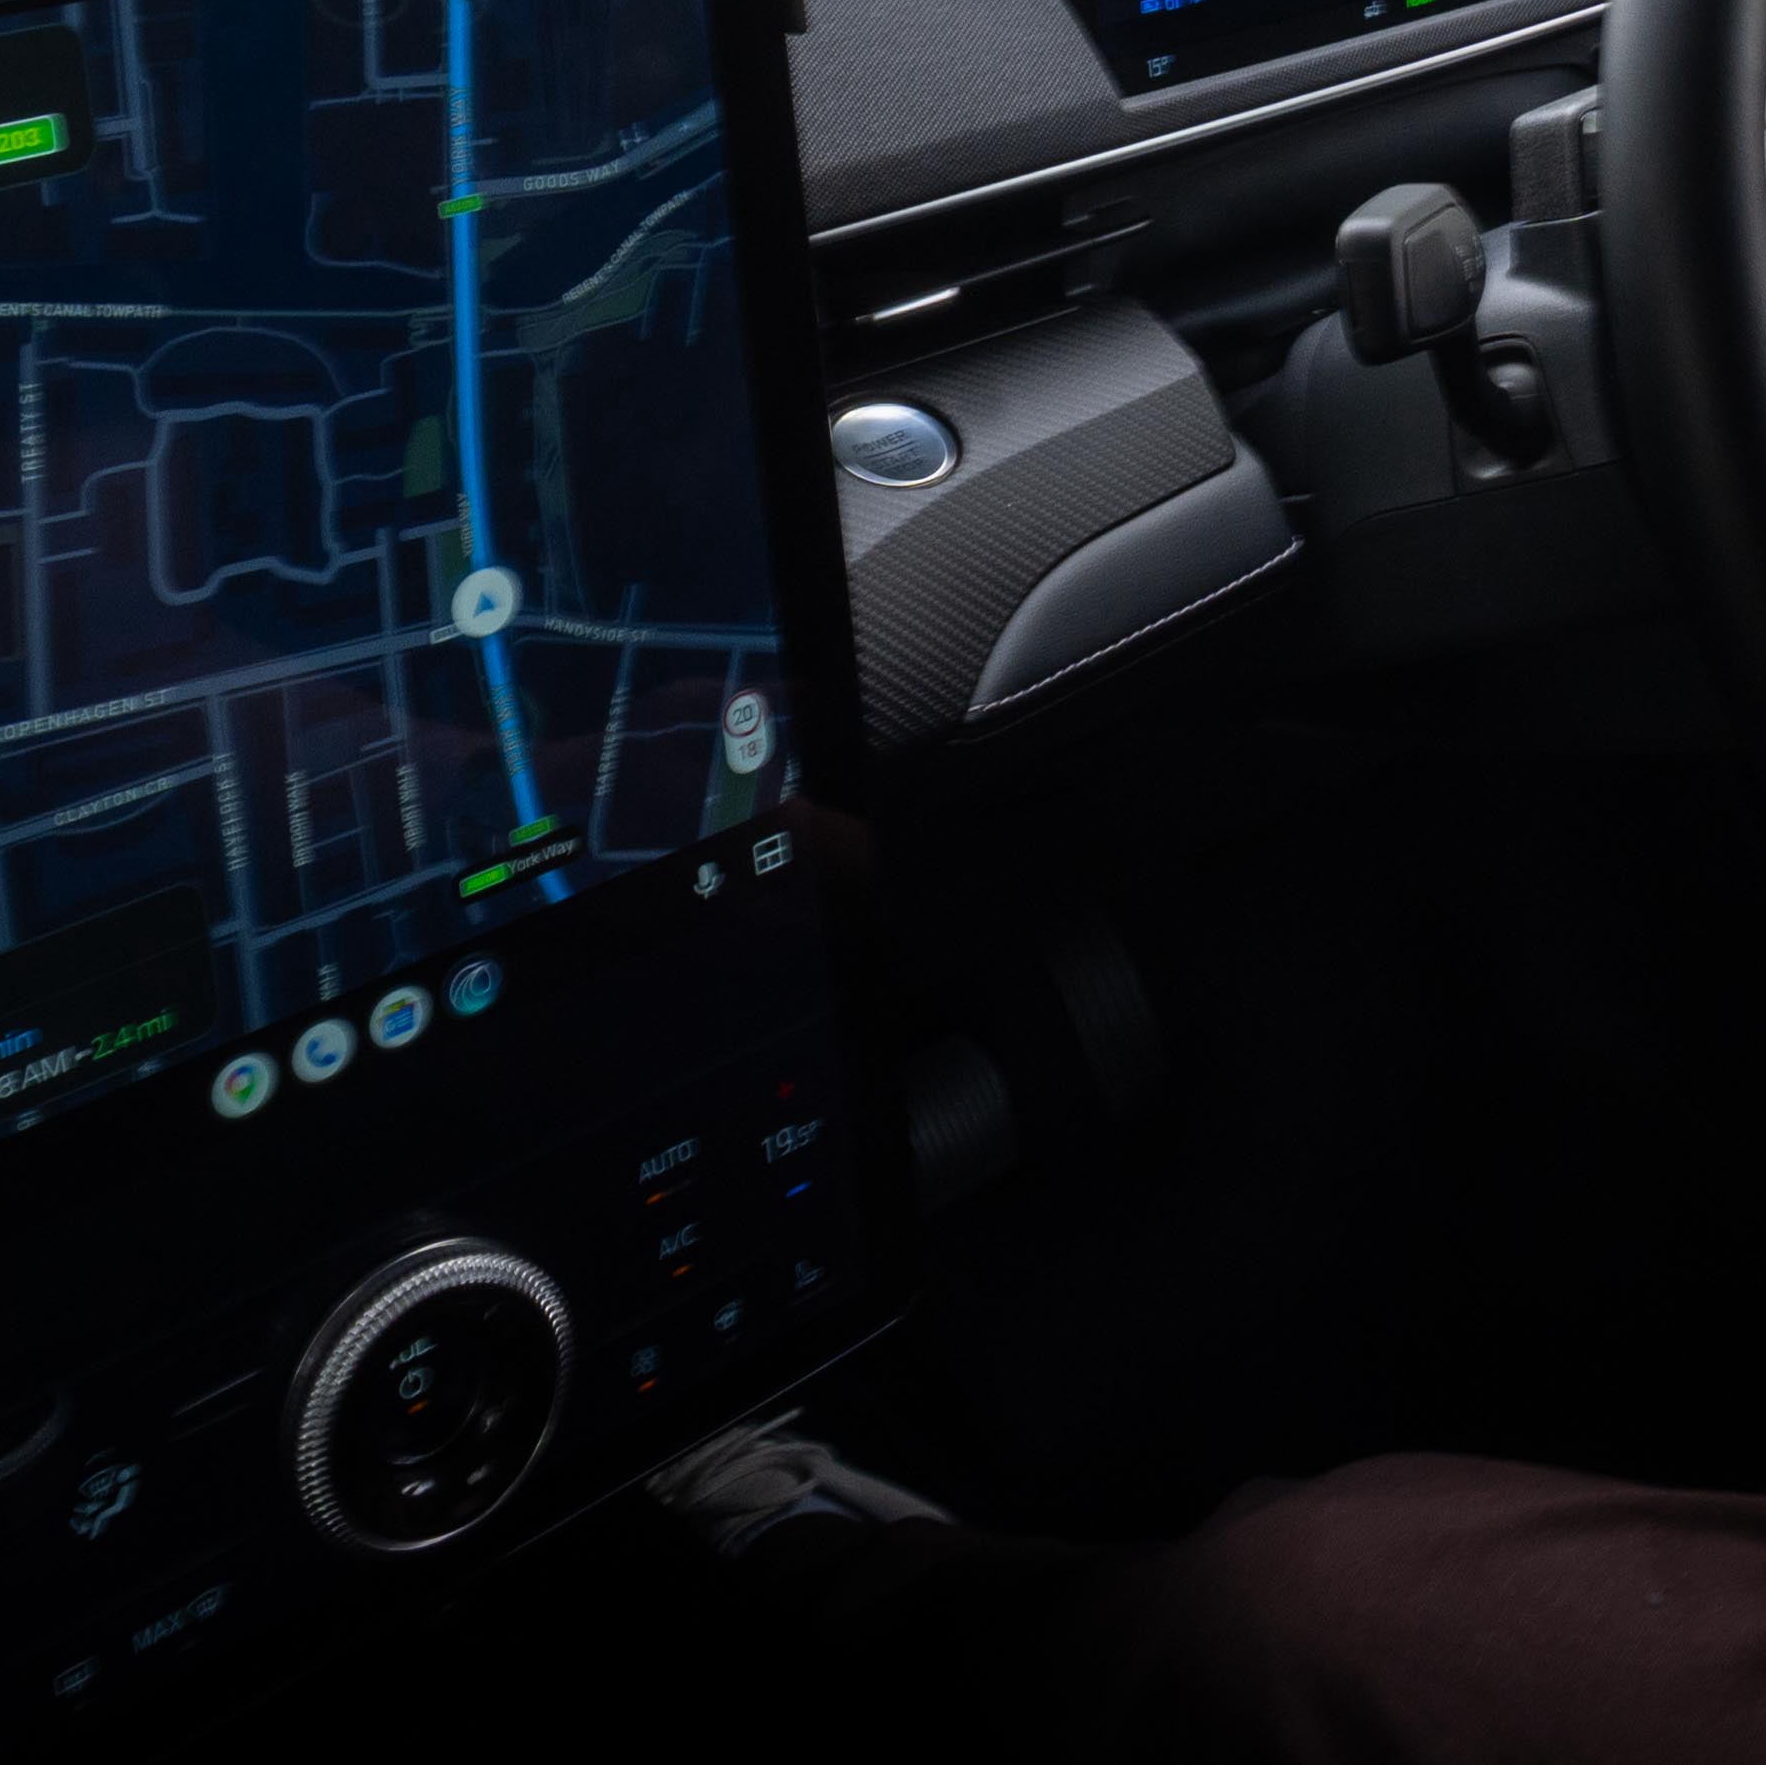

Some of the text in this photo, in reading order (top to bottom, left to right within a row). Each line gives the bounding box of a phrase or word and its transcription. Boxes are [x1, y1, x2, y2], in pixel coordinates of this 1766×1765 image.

[522, 160, 623, 191] GOODS WAY
[19, 412, 46, 484] TREATY
[851, 429, 907, 454] POWER
[542, 615, 650, 643] HANDYSIDE ST
[137, 690, 169, 711] ST
[732, 704, 754, 727] 20
[540, 839, 581, 864] Way
[637, 1137, 700, 1185] AUTO
[658, 1221, 702, 1261] A/C
[130, 1608, 188, 1657] MAX
